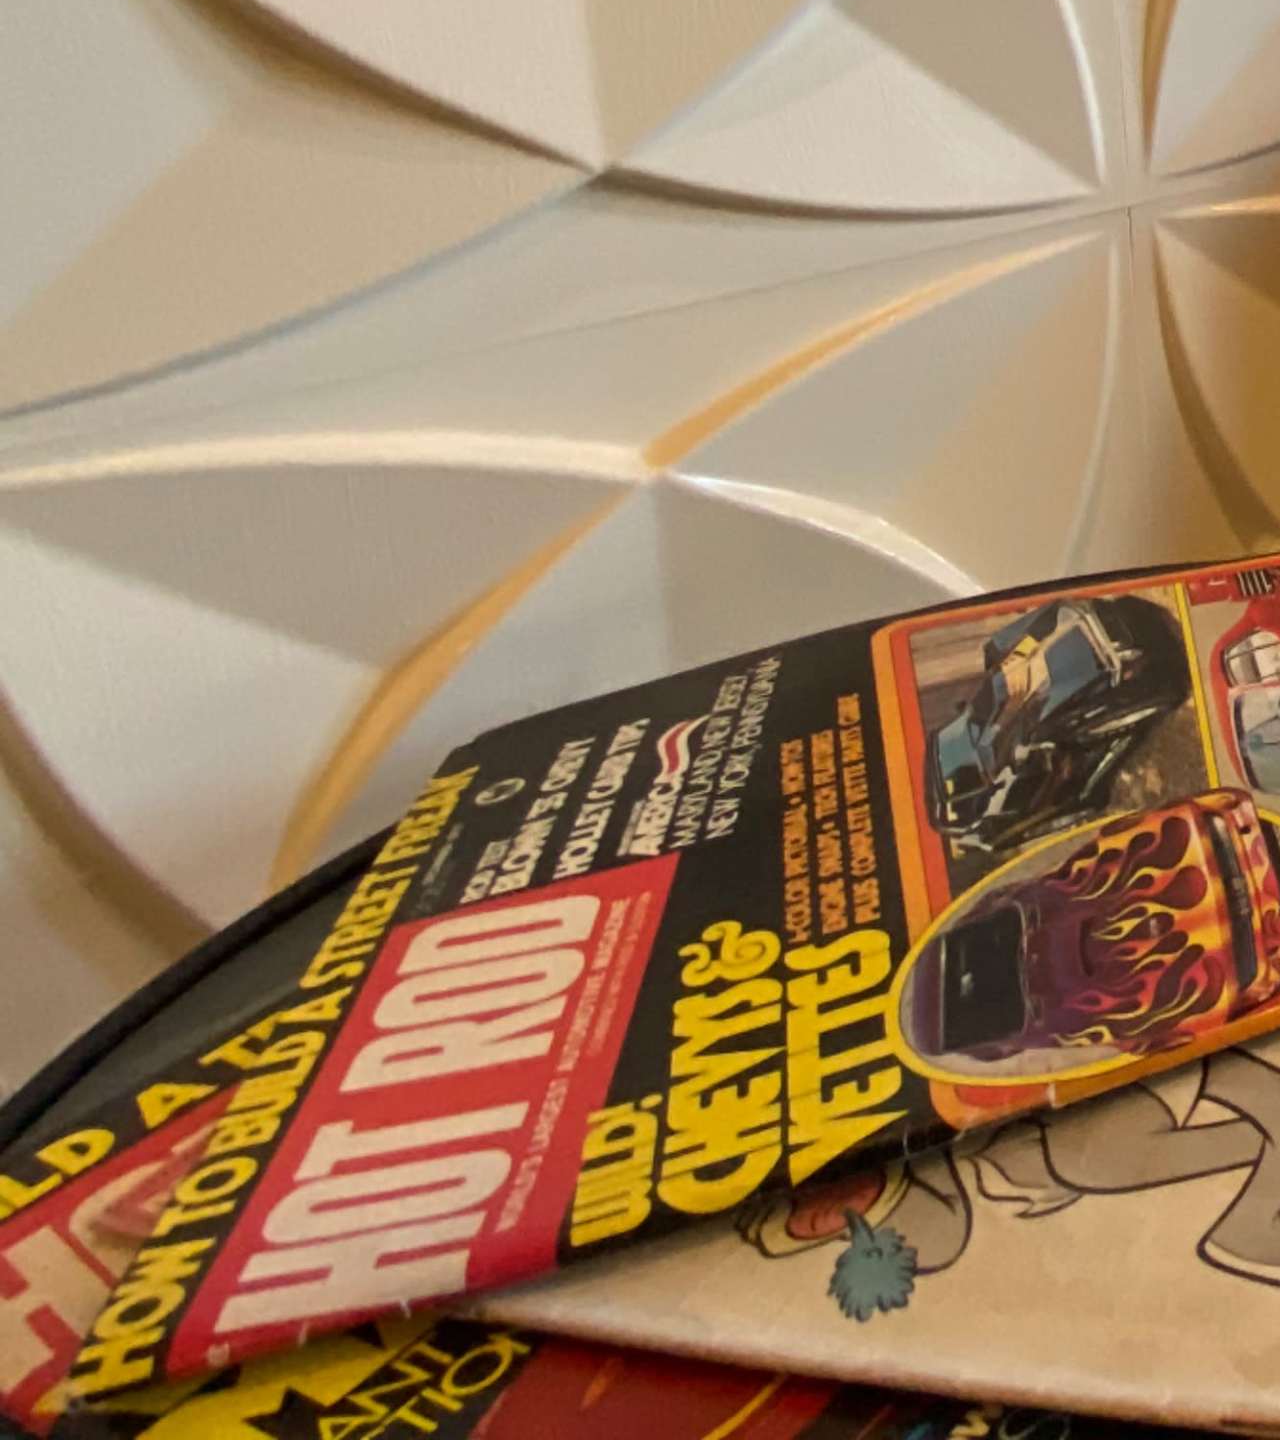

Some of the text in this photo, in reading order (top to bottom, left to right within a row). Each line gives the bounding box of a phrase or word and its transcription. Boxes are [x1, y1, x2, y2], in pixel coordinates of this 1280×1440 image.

[372, 765, 480, 865] FREAK
[488, 815, 557, 896] BLOWN
[540, 736, 596, 792] CHEVY
[552, 799, 615, 880] HOLLEY
[704, 797, 742, 840] NEW
[300, 863, 420, 988] STREET
[272, 985, 353, 1023] A
[784, 928, 910, 1187] VETTES
[136, 1082, 220, 1129] A
[205, 1031, 326, 1156] BUILD
[214, 895, 600, 1334] HOT ROD
[656, 920, 787, 1214] CHEVYS &
[150, 1156, 258, 1237] TO
[570, 1093, 664, 1248] WILD!
[32, 1236, 218, 1414] HOW
